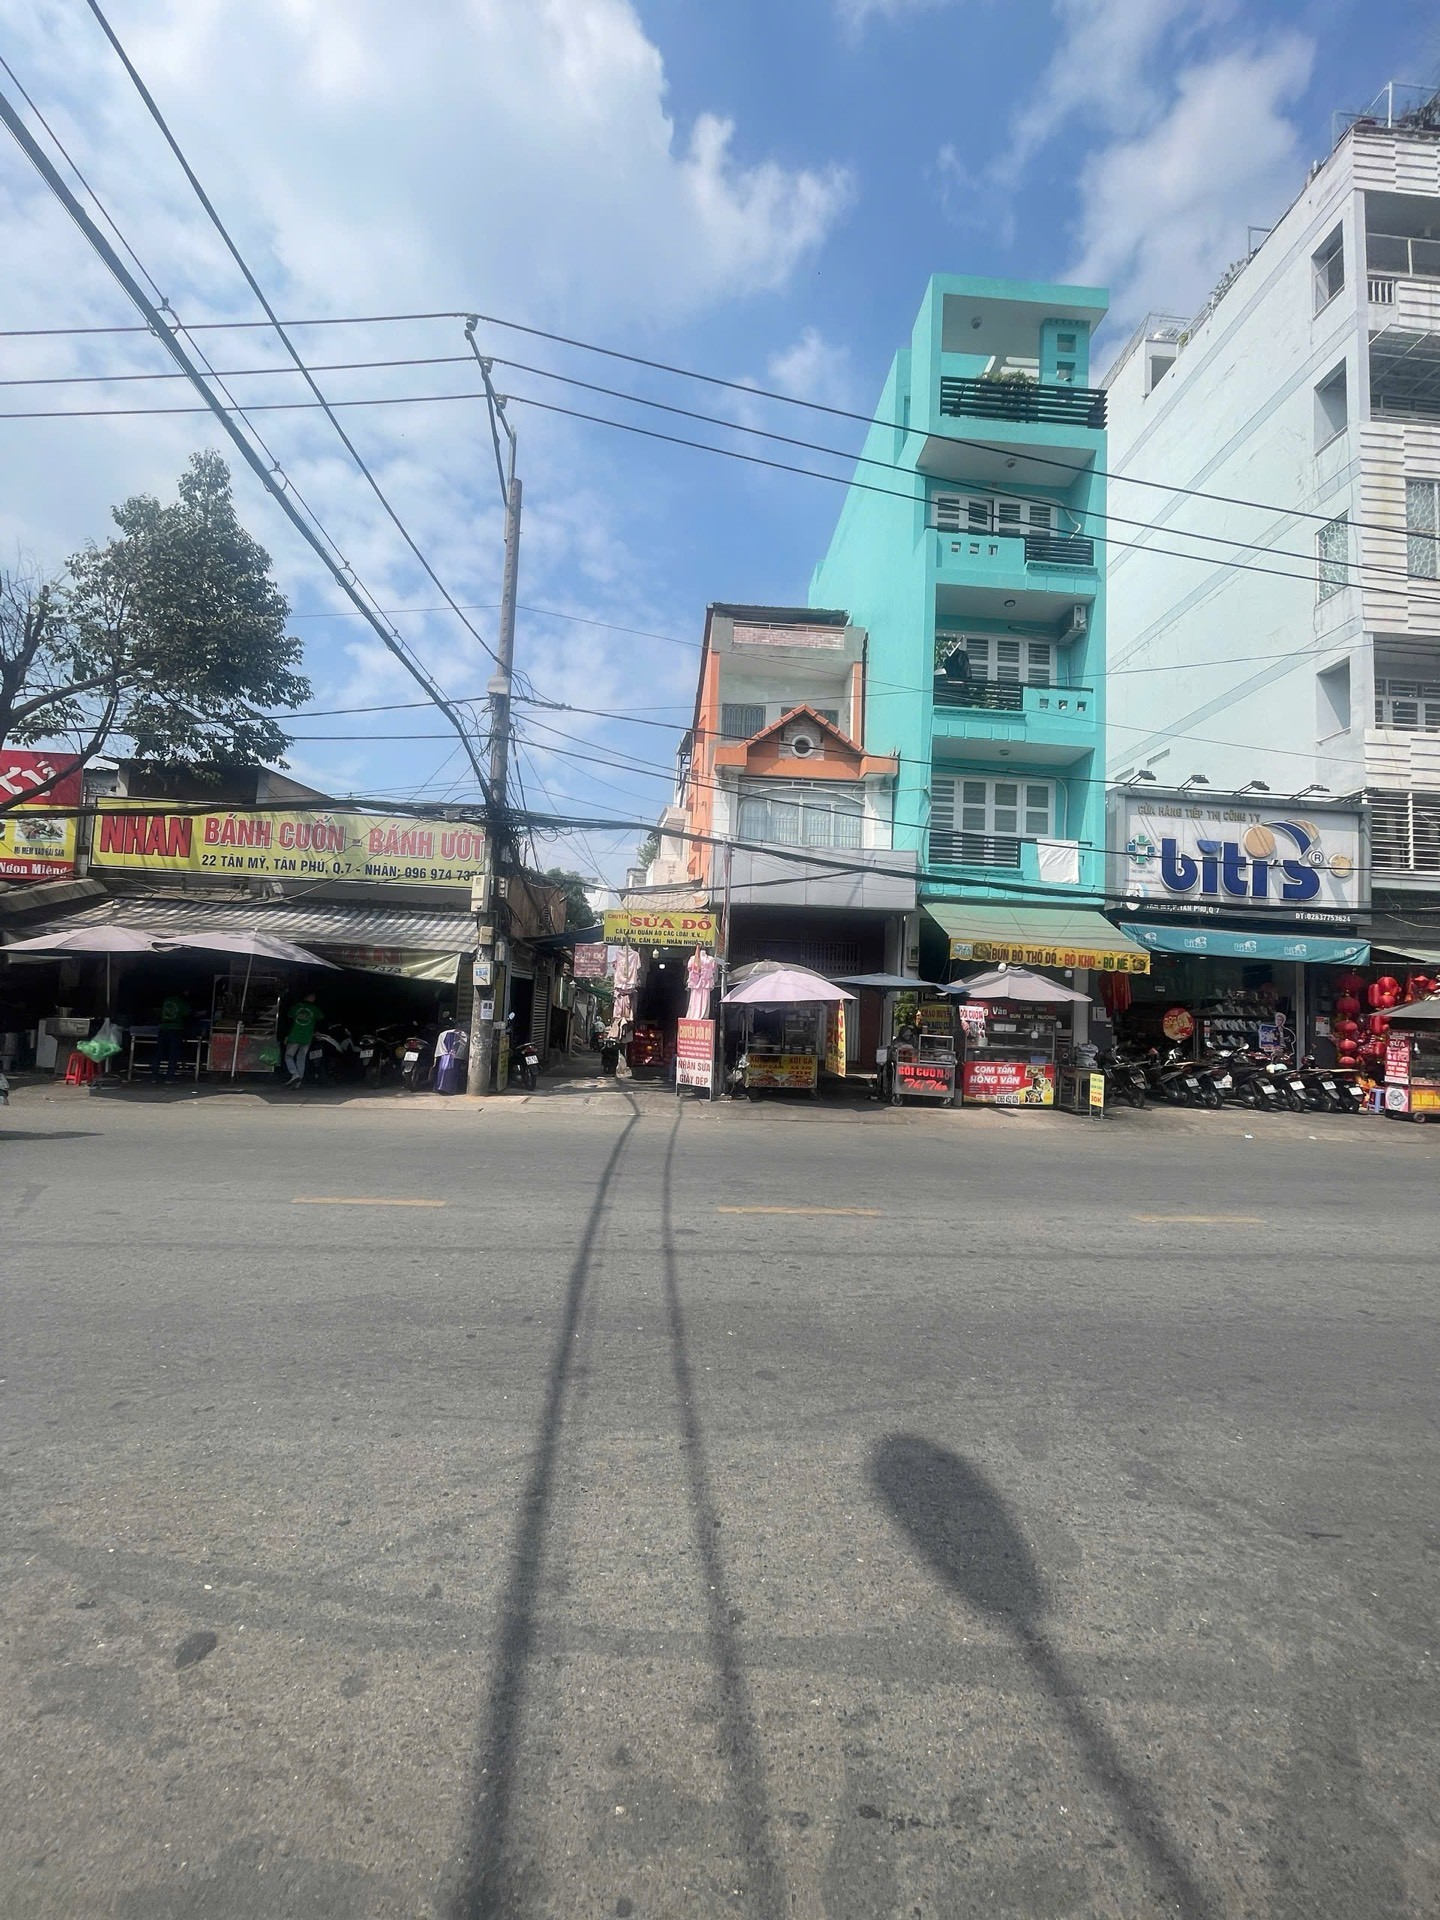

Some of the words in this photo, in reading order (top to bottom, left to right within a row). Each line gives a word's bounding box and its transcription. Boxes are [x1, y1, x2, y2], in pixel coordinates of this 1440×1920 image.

[1138, 802, 1155, 815] CỬA
[1158, 805, 1182, 817] HÀNG
[1185, 804, 1203, 819] TIẾP
[1207, 810, 1221, 823] THỊ
[1223, 810, 1246, 822] CÔNG
[1249, 813, 1261, 823] TY
[204, 814, 273, 850] BÁNH
[279, 816, 347, 853] CUỐN
[368, 824, 434, 859] BÁNH
[440, 829, 486, 862] ƯỚT
[0, 862, 27, 875] Ngon
[201, 855, 216, 866] 22
[221, 855, 244, 868] TÂN
[273, 856, 296, 870] TÂN
[300, 859, 328, 874] PHÚ,
[332, 863, 352, 874] Q.7
[365, 863, 401, 877] NHÂN:
[405, 867, 427, 878] 096
[430, 869, 452, 880] 974
[630, 914, 675, 929] SỬA
[681, 915, 712, 930] ĐỒ
[992, 944, 1009, 961] BÚN
[1012, 945, 1024, 961] BÒ
[1045, 948, 1057, 964] ĐÁ
[1064, 950, 1076, 966] BÒ
[1078, 954, 1096, 968] KHO
[1103, 953, 1114, 969] BÒ
[1117, 954, 1128, 970] NÉ
